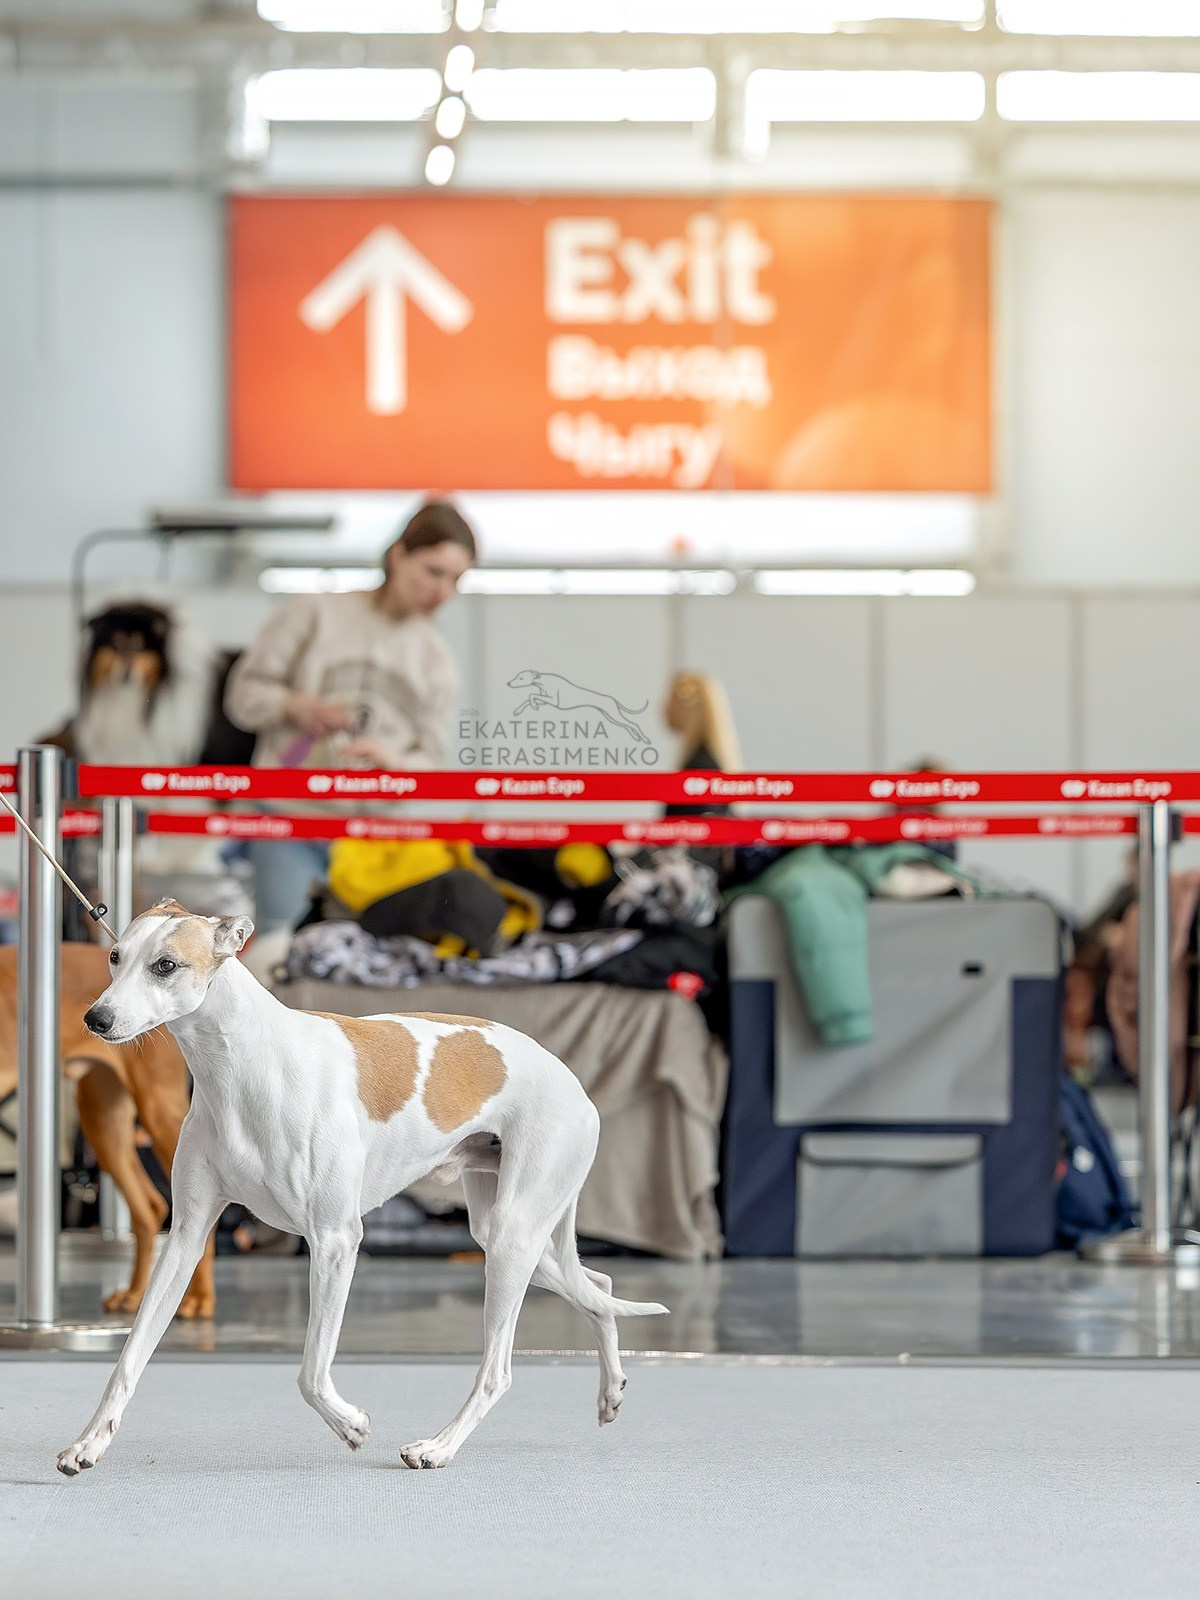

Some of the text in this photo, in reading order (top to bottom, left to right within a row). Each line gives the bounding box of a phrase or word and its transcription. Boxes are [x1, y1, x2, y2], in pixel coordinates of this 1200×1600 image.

[544, 212, 776, 327] Exit
[545, 334, 772, 409] Выход
[213, 772, 251, 792] Expo
[379, 774, 417, 794] Expo
[547, 776, 585, 796] Expo
[755, 777, 794, 797] Expo
[941, 778, 981, 798] Expo
[1133, 778, 1173, 798] Expo
